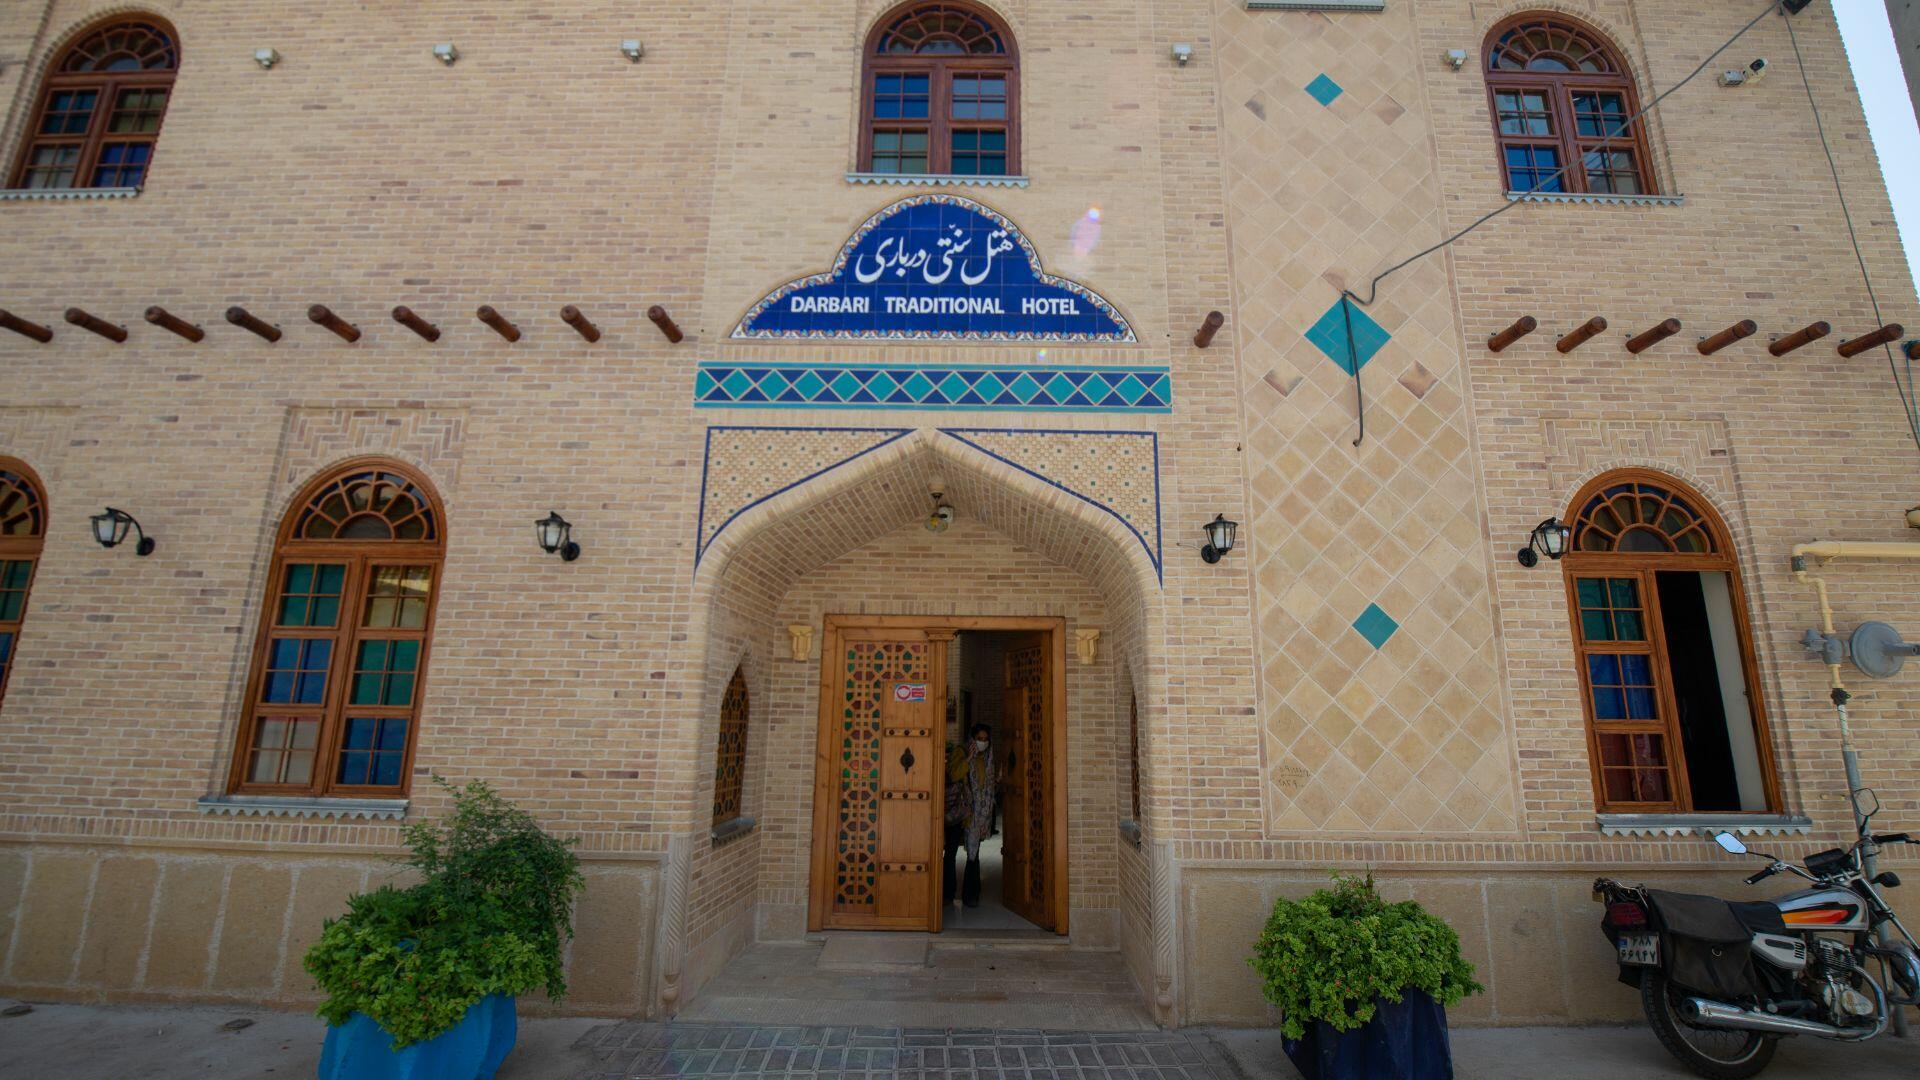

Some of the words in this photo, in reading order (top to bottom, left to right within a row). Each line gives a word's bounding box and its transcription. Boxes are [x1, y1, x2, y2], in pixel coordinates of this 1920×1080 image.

[855, 237, 927, 284] درباری
[961, 228, 1014, 286] هتل
[791, 297, 869, 313] DARBARI
[885, 297, 1005, 314] TRADITIONAL
[1022, 298, 1080, 315] HOTEL
